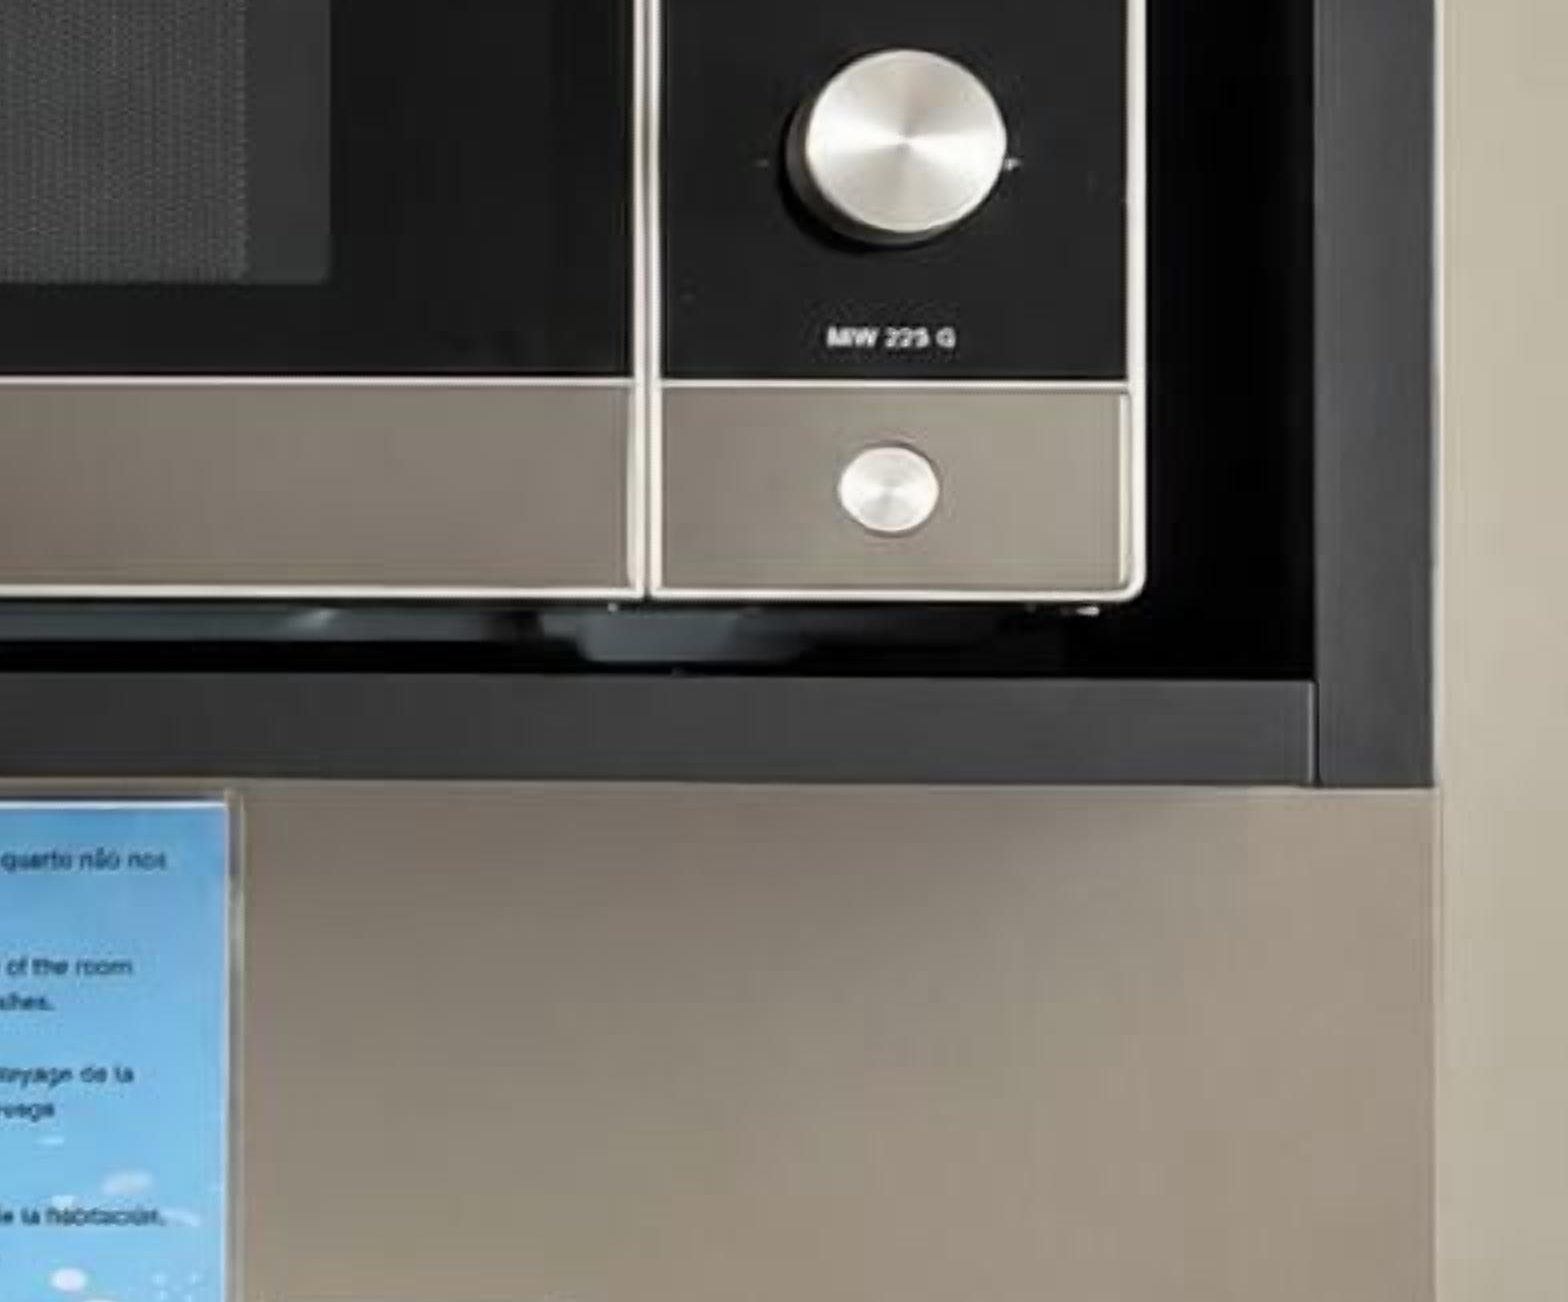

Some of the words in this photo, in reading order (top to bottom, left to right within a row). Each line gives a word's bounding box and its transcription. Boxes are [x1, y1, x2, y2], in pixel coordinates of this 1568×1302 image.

[827, 327, 880, 348] MW
[7, 956, 28, 975] of
[32, 956, 68, 975] the
[76, 960, 133, 975] room
